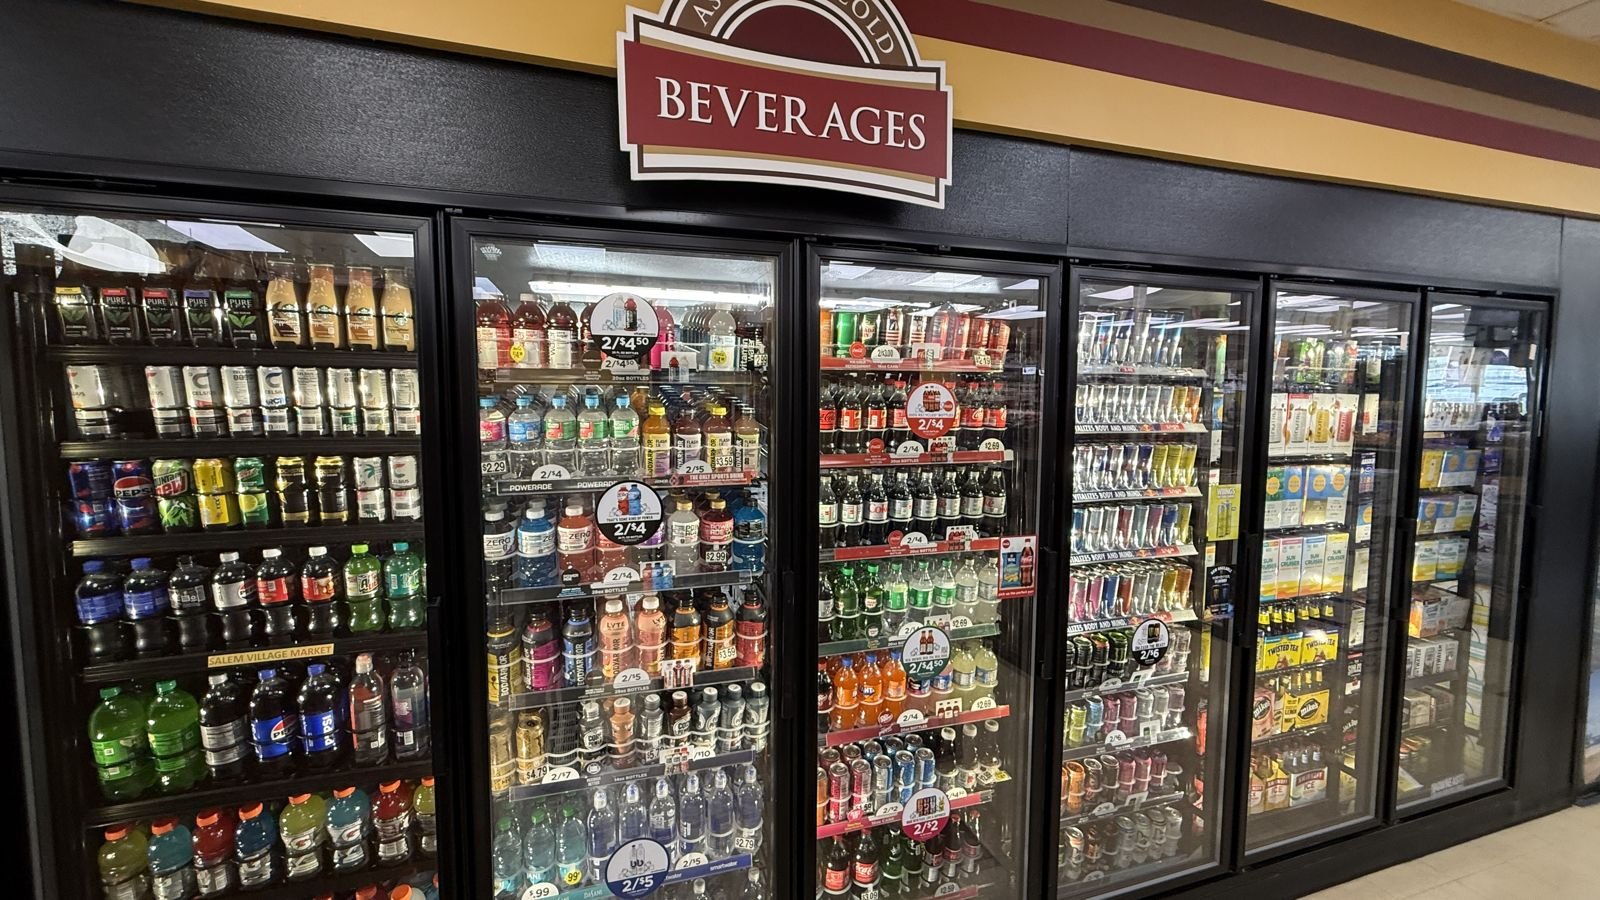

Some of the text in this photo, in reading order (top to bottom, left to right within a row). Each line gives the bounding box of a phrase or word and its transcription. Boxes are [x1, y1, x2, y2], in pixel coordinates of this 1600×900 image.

[655, 76, 926, 150] BEVERAGES
[106, 296, 126, 305] PURE
[147, 298, 167, 306] PURE
[188, 298, 209, 306] PURE
[229, 299, 252, 307] PURE
[918, 419, 944, 430] 2/$4
[716, 456, 734, 467] $3.59
[482, 462, 506, 473] $2.29
[686, 465, 705, 474] 2/$5
[540, 470, 562, 479] 2/$4
[509, 484, 553, 493] POWERADE
[614, 523, 647, 536] 2/$4
[568, 530, 591, 540] ZERO
[485, 536, 511, 547] ZERO
[706, 551, 726, 562] $2.99
[1070, 554, 1091, 562] TALIZES
[1092, 553, 1106, 561] BODY
[612, 571, 632, 581] 2/$4
[952, 618, 968, 628] $2.69
[1084, 623, 1099, 631] BODY
[1100, 621, 1112, 629] AND
[1267, 644, 1299, 657] TWISTED TEA
[1306, 641, 1325, 650] TWIS
[209, 644, 332, 666] SALEM VILLAGE MARKET
[719, 647, 736, 659] $3.59
[1140, 649, 1159, 660] 2/$6
[622, 673, 641, 682] 2/$5
[902, 714, 918, 722] 2/$4
[693, 750, 711, 759] /$10
[526, 766, 547, 779] $4.79
[551, 771, 571, 780] 2/$7
[1304, 782, 1315, 790] ICE
[913, 820, 939, 835] 2/$2
[736, 838, 754, 848] $2.79
[683, 857, 701, 867] 2/$5
[710, 860, 737, 871] smartwater
[622, 875, 654, 893] 2/$5
[528, 887, 550, 899] $.99
